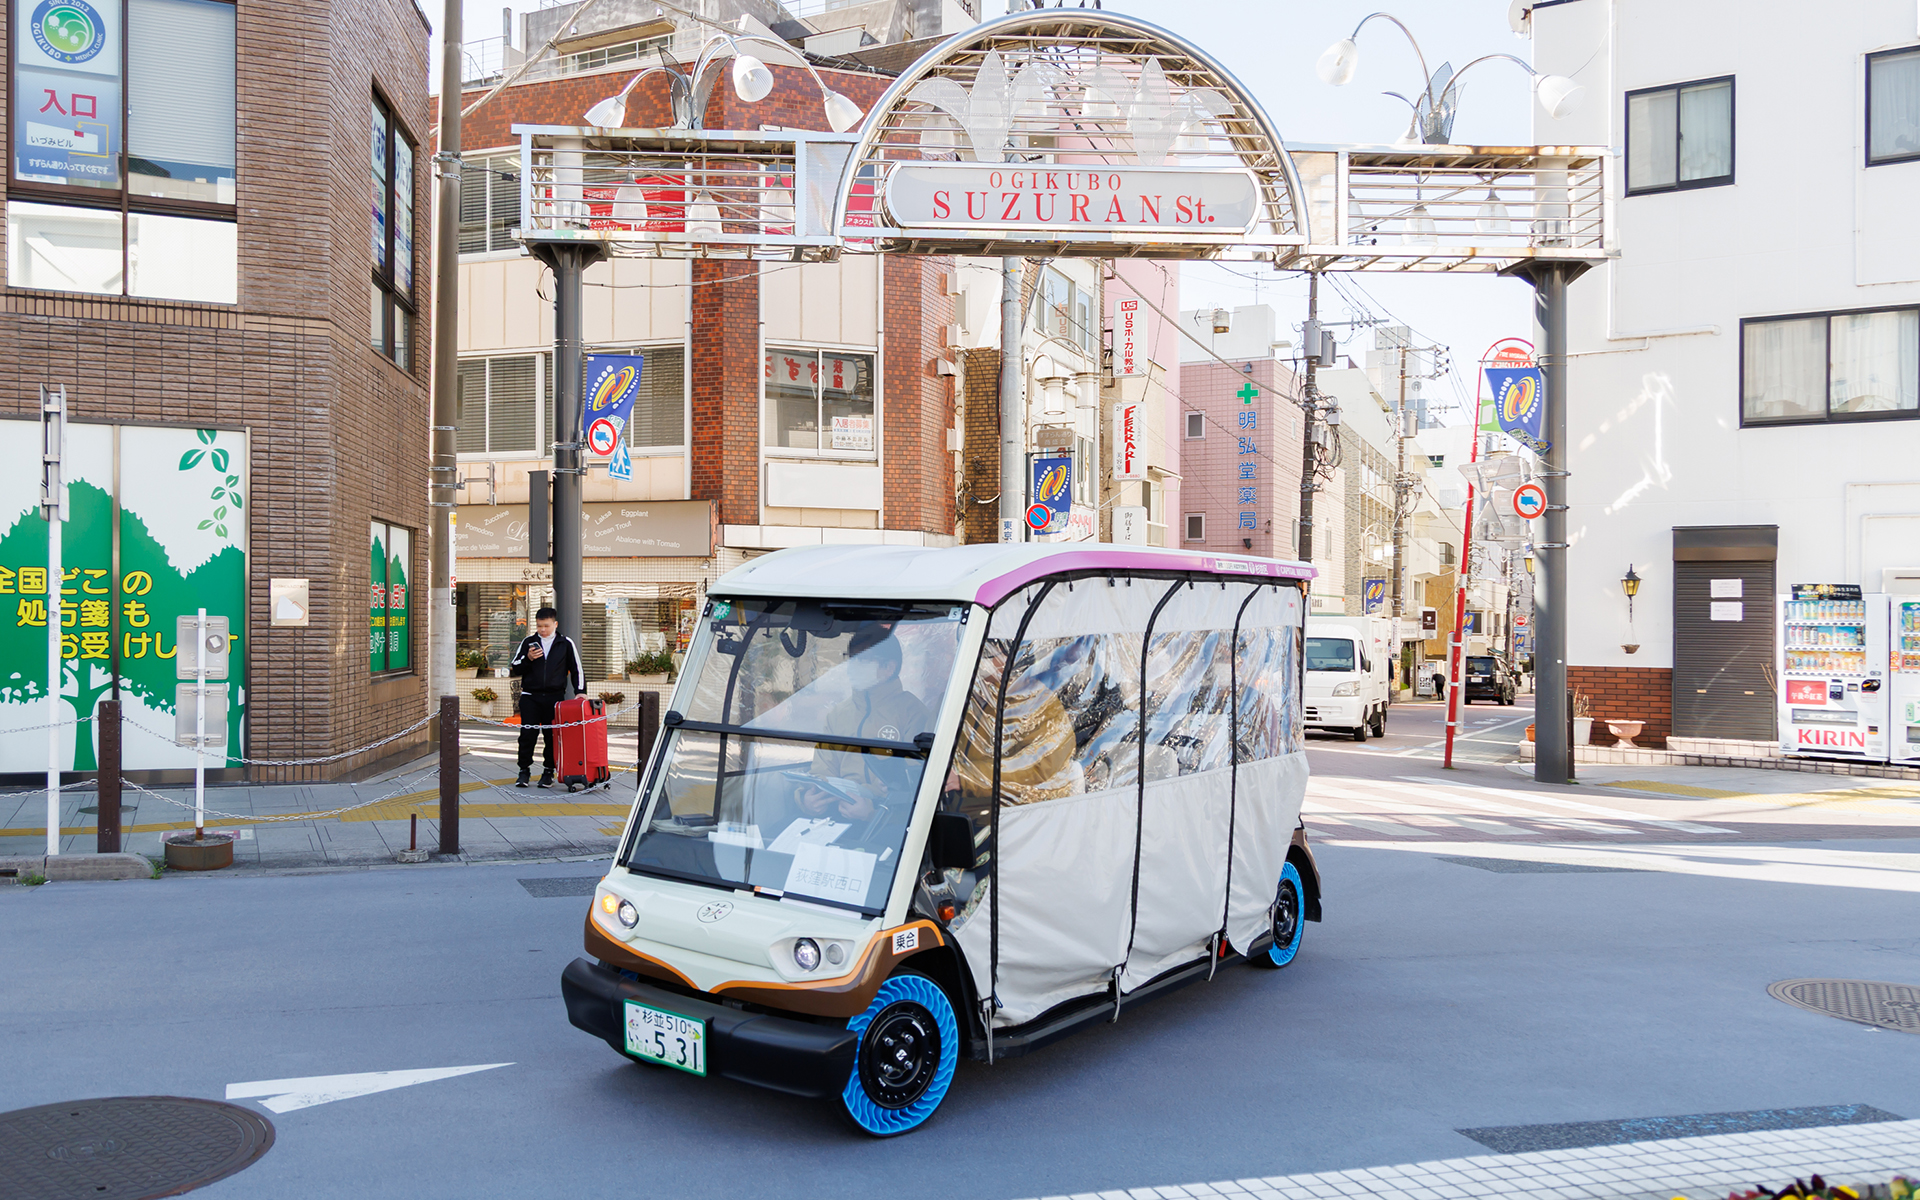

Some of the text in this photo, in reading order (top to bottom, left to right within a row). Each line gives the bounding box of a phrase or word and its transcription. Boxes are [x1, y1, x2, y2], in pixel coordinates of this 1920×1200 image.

[71, 0, 90, 13] 2012
[32, 22, 61, 59] OGIKUBO
[75, 33, 104, 61] MEDICAL CLINIC
[39, 88, 97, 119] 入口
[30, 136, 74, 148] いづみビル
[990, 171, 1122, 191] OGIKUBO
[933, 190, 1215, 224] SUZURAN St.
[1124, 405, 1136, 473] FERRARI
[1238, 411, 1257, 530] 明弘堂薬局
[484, 510, 510, 526] Zucchine
[594, 510, 613, 525] Laksa
[621, 509, 649, 518] Eggplant
[465, 523, 494, 537] Pomodoro
[594, 527, 615, 538] Ocean
[615, 520, 632, 531] Trout
[615, 536, 641, 544] Abalone
[656, 540, 680, 548] Tomato
[17, 599, 150, 627] 処方箋も
[1798, 729, 1865, 747] KIRIN
[795, 868, 862, 893] 荻窪駅西口
[896, 931, 915, 951] 乗合
[628, 1030, 639, 1043] い
